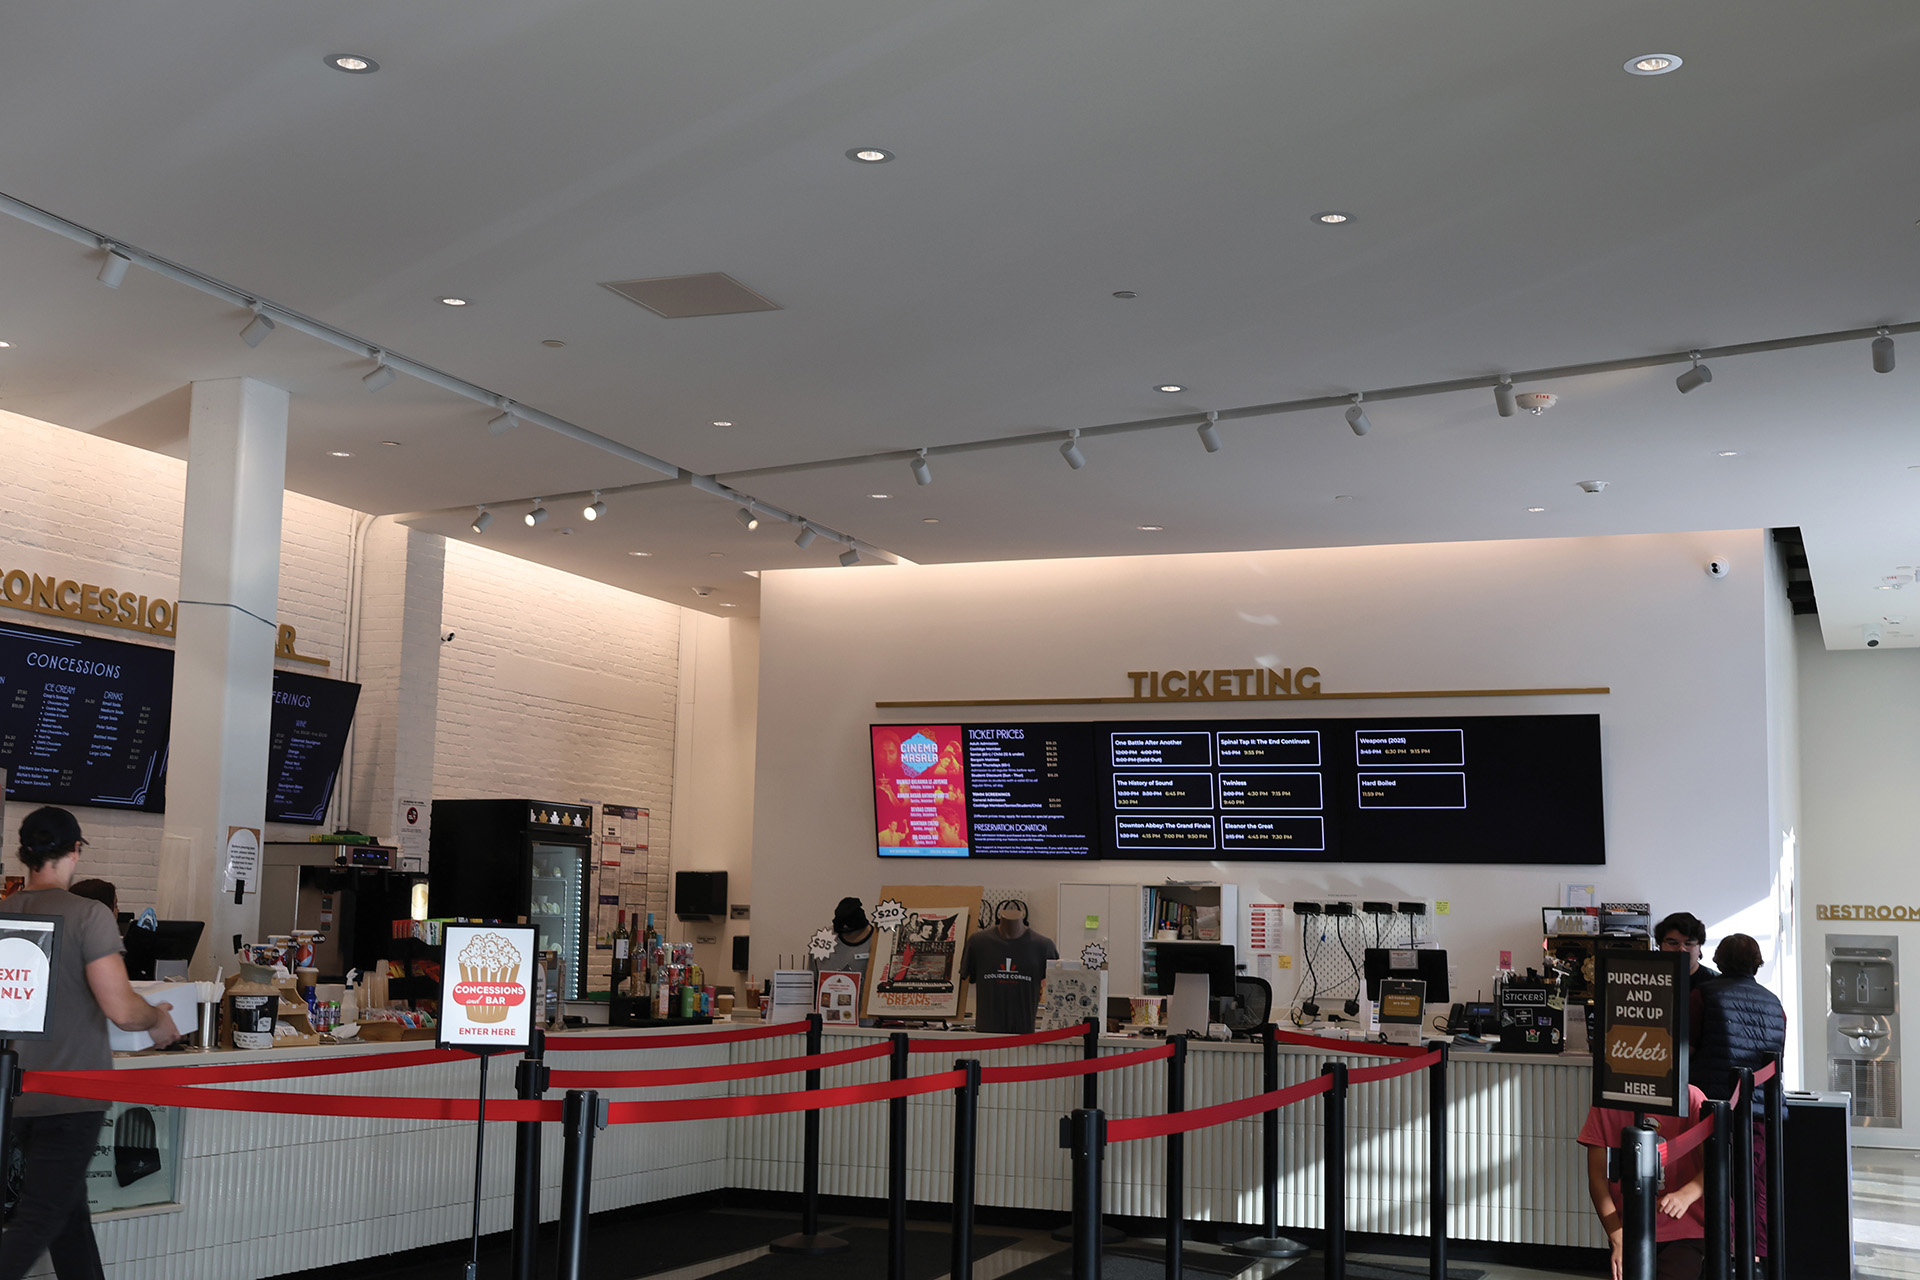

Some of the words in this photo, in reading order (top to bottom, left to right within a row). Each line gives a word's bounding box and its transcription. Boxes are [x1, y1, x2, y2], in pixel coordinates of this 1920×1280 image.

[0, 568, 178, 633] ONCESSIO
[26, 652, 120, 679] CONCESSIONS
[1128, 666, 1320, 697] TICKETING
[44, 683, 55, 692] ICE
[55, 684, 76, 694] CREAM
[104, 691, 124, 701] DRINKS
[968, 729, 995, 739] TICKET
[996, 729, 1024, 739] PRICES
[900, 743, 938, 753] CINEMA
[901, 753, 938, 762] MASALA
[878, 908, 899, 919] $20
[1816, 904, 1920, 920] RESTROOM
[813, 938, 832, 950] $35
[1608, 972, 1672, 986] PURCHASE
[455, 986, 524, 995] CONCESSIONS
[1626, 990, 1652, 1002] AND
[466, 995, 484, 1004] and
[485, 996, 506, 1004] BAR
[886, 998, 930, 1006] DREAMS
[1505, 993, 1544, 1002] STICKERS
[1616, 1006, 1644, 1019] PICK
[1647, 1008, 1664, 1019] UP
[1611, 1032, 1667, 1061] tickets
[1624, 1082, 1656, 1096] HERE
